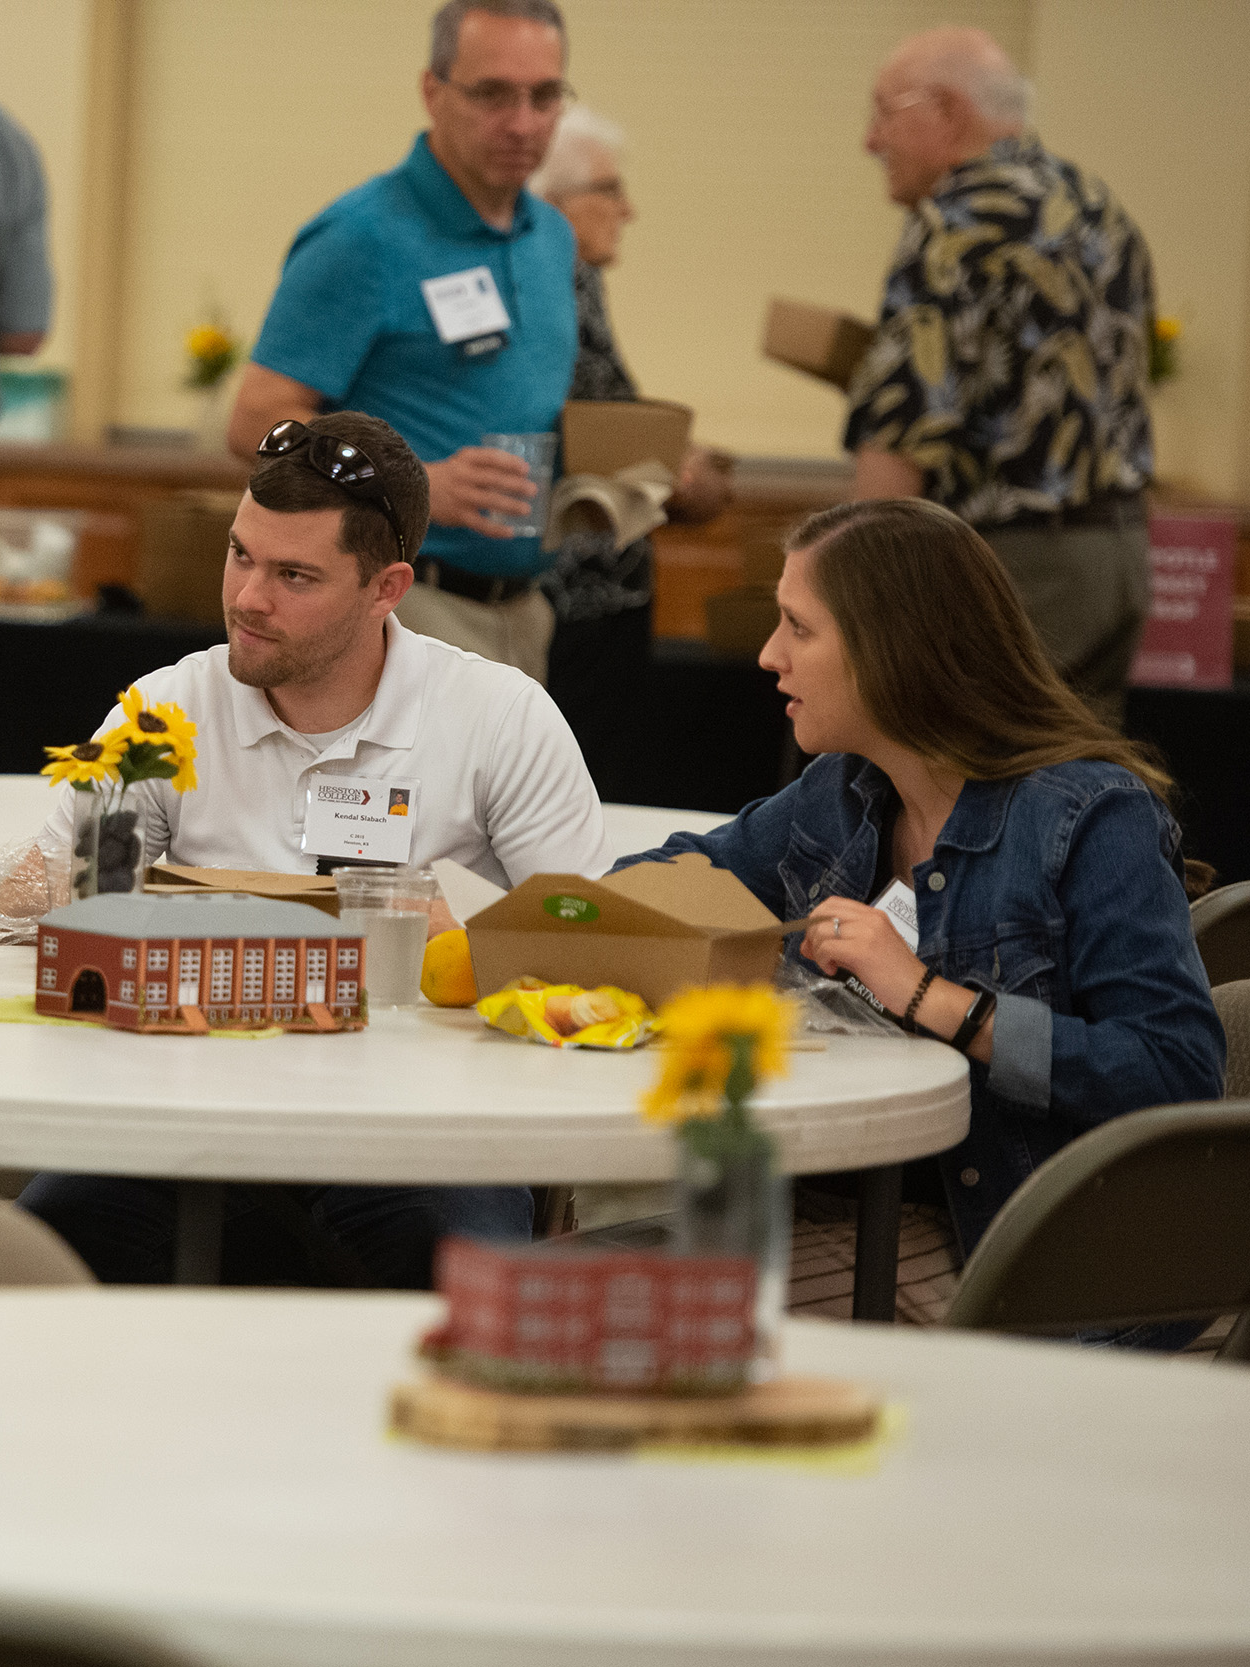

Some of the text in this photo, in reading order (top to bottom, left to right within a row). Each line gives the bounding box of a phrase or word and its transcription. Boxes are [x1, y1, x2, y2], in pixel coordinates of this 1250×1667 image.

[318, 785, 361, 795] HESSTON
[317, 792, 361, 801] COLLEGE
[334, 812, 387, 823] Kendal Slabach
[846, 976, 885, 1013] PARTNER
